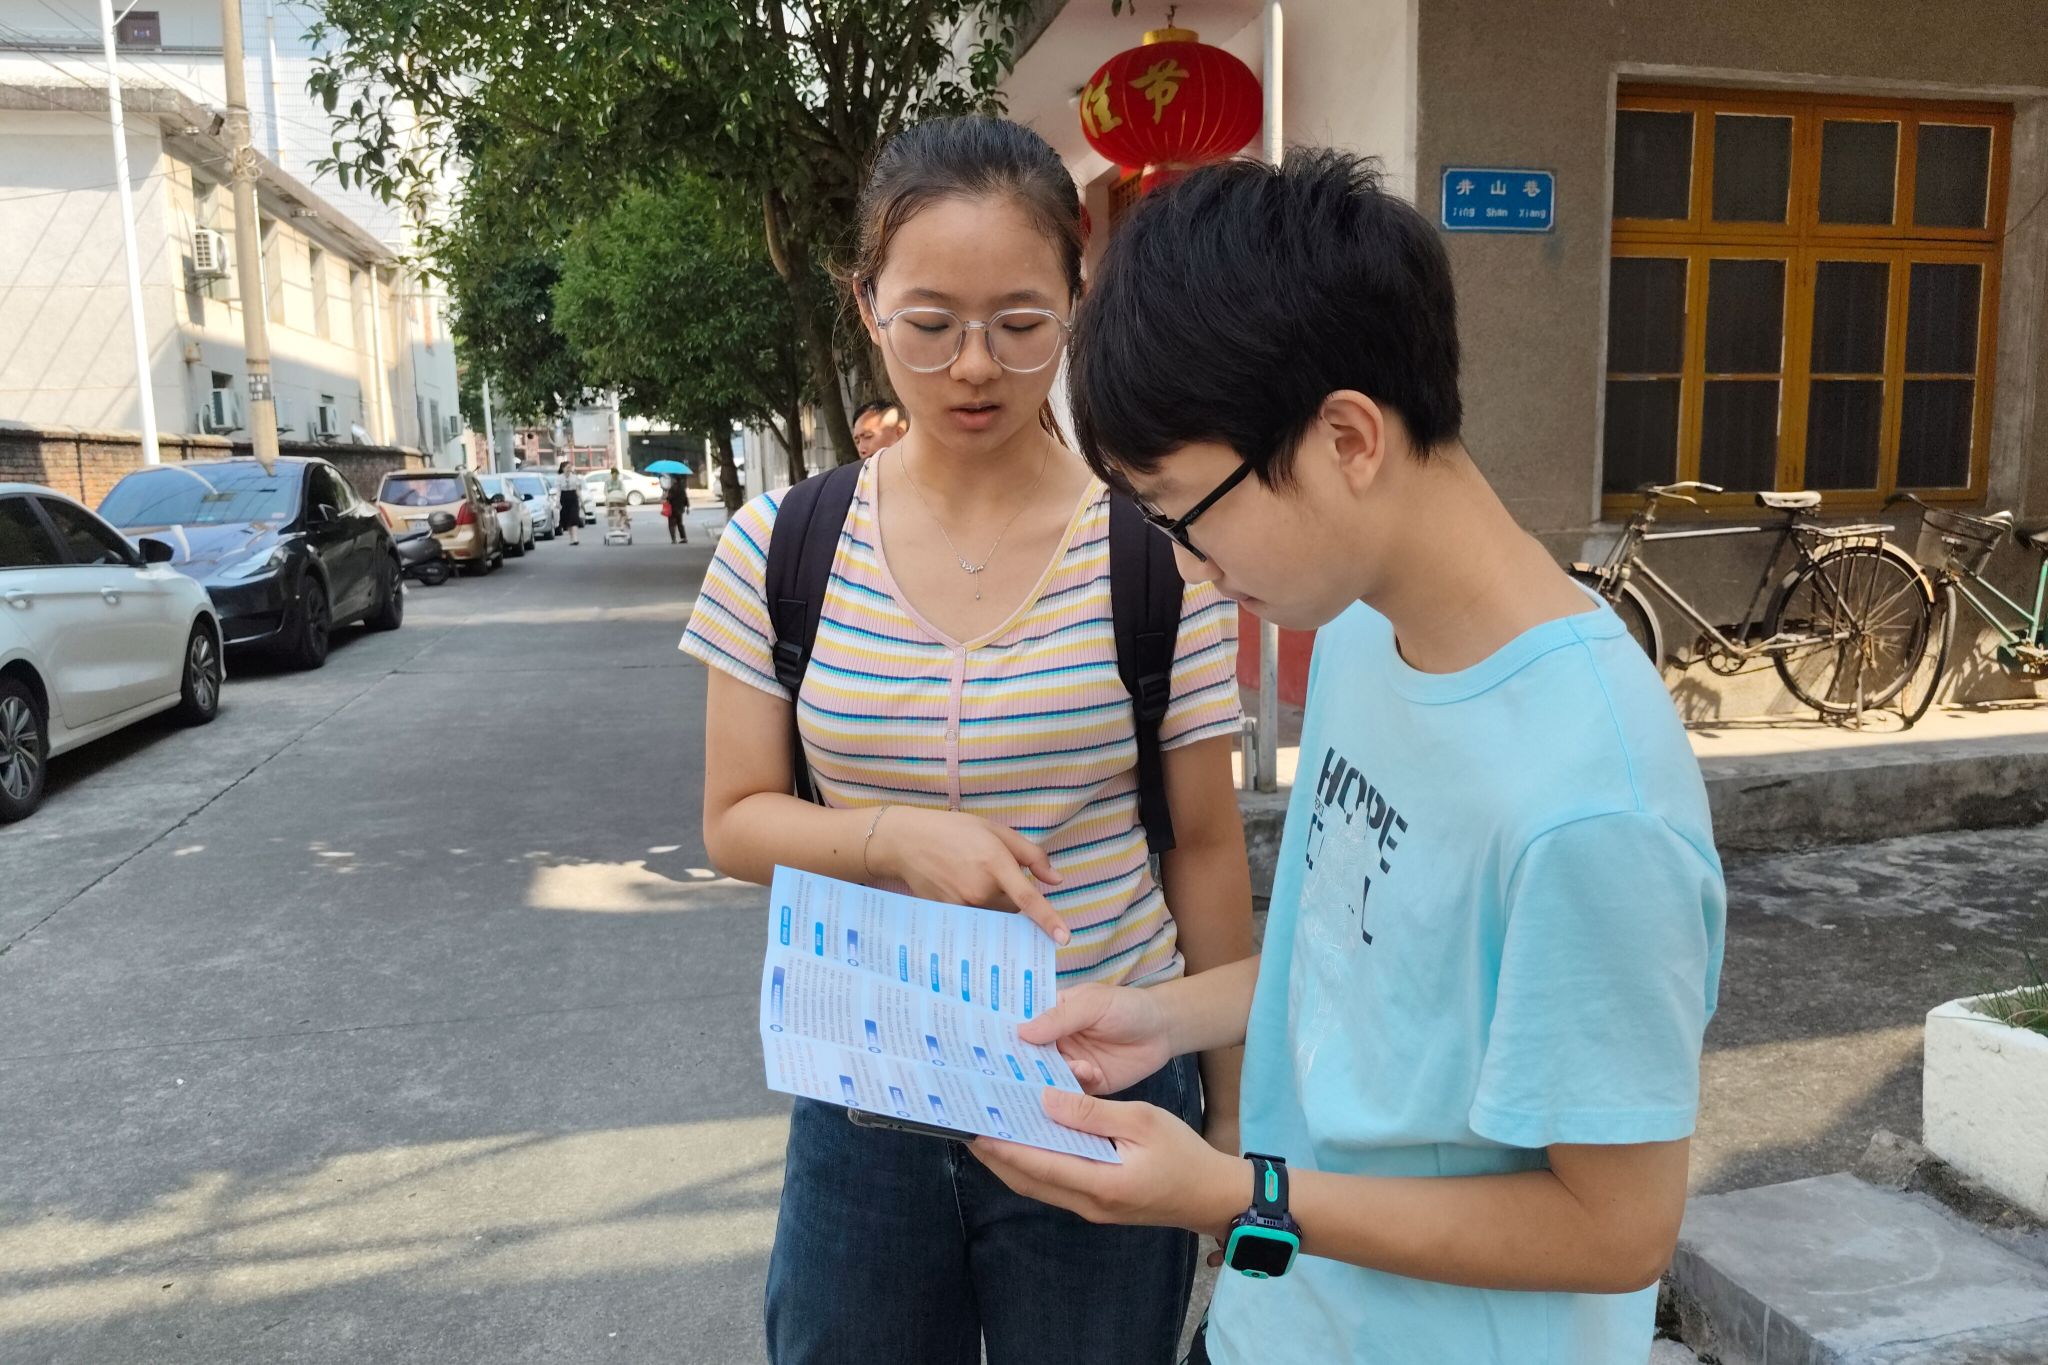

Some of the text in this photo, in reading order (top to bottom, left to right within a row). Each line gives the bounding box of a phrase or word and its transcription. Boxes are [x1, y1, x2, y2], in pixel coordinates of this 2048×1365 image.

[1456, 178, 1541, 197] 井山巷
[1452, 207, 1547, 219] Jing Shan Xiang
[1316, 746, 1408, 874] HOPE
